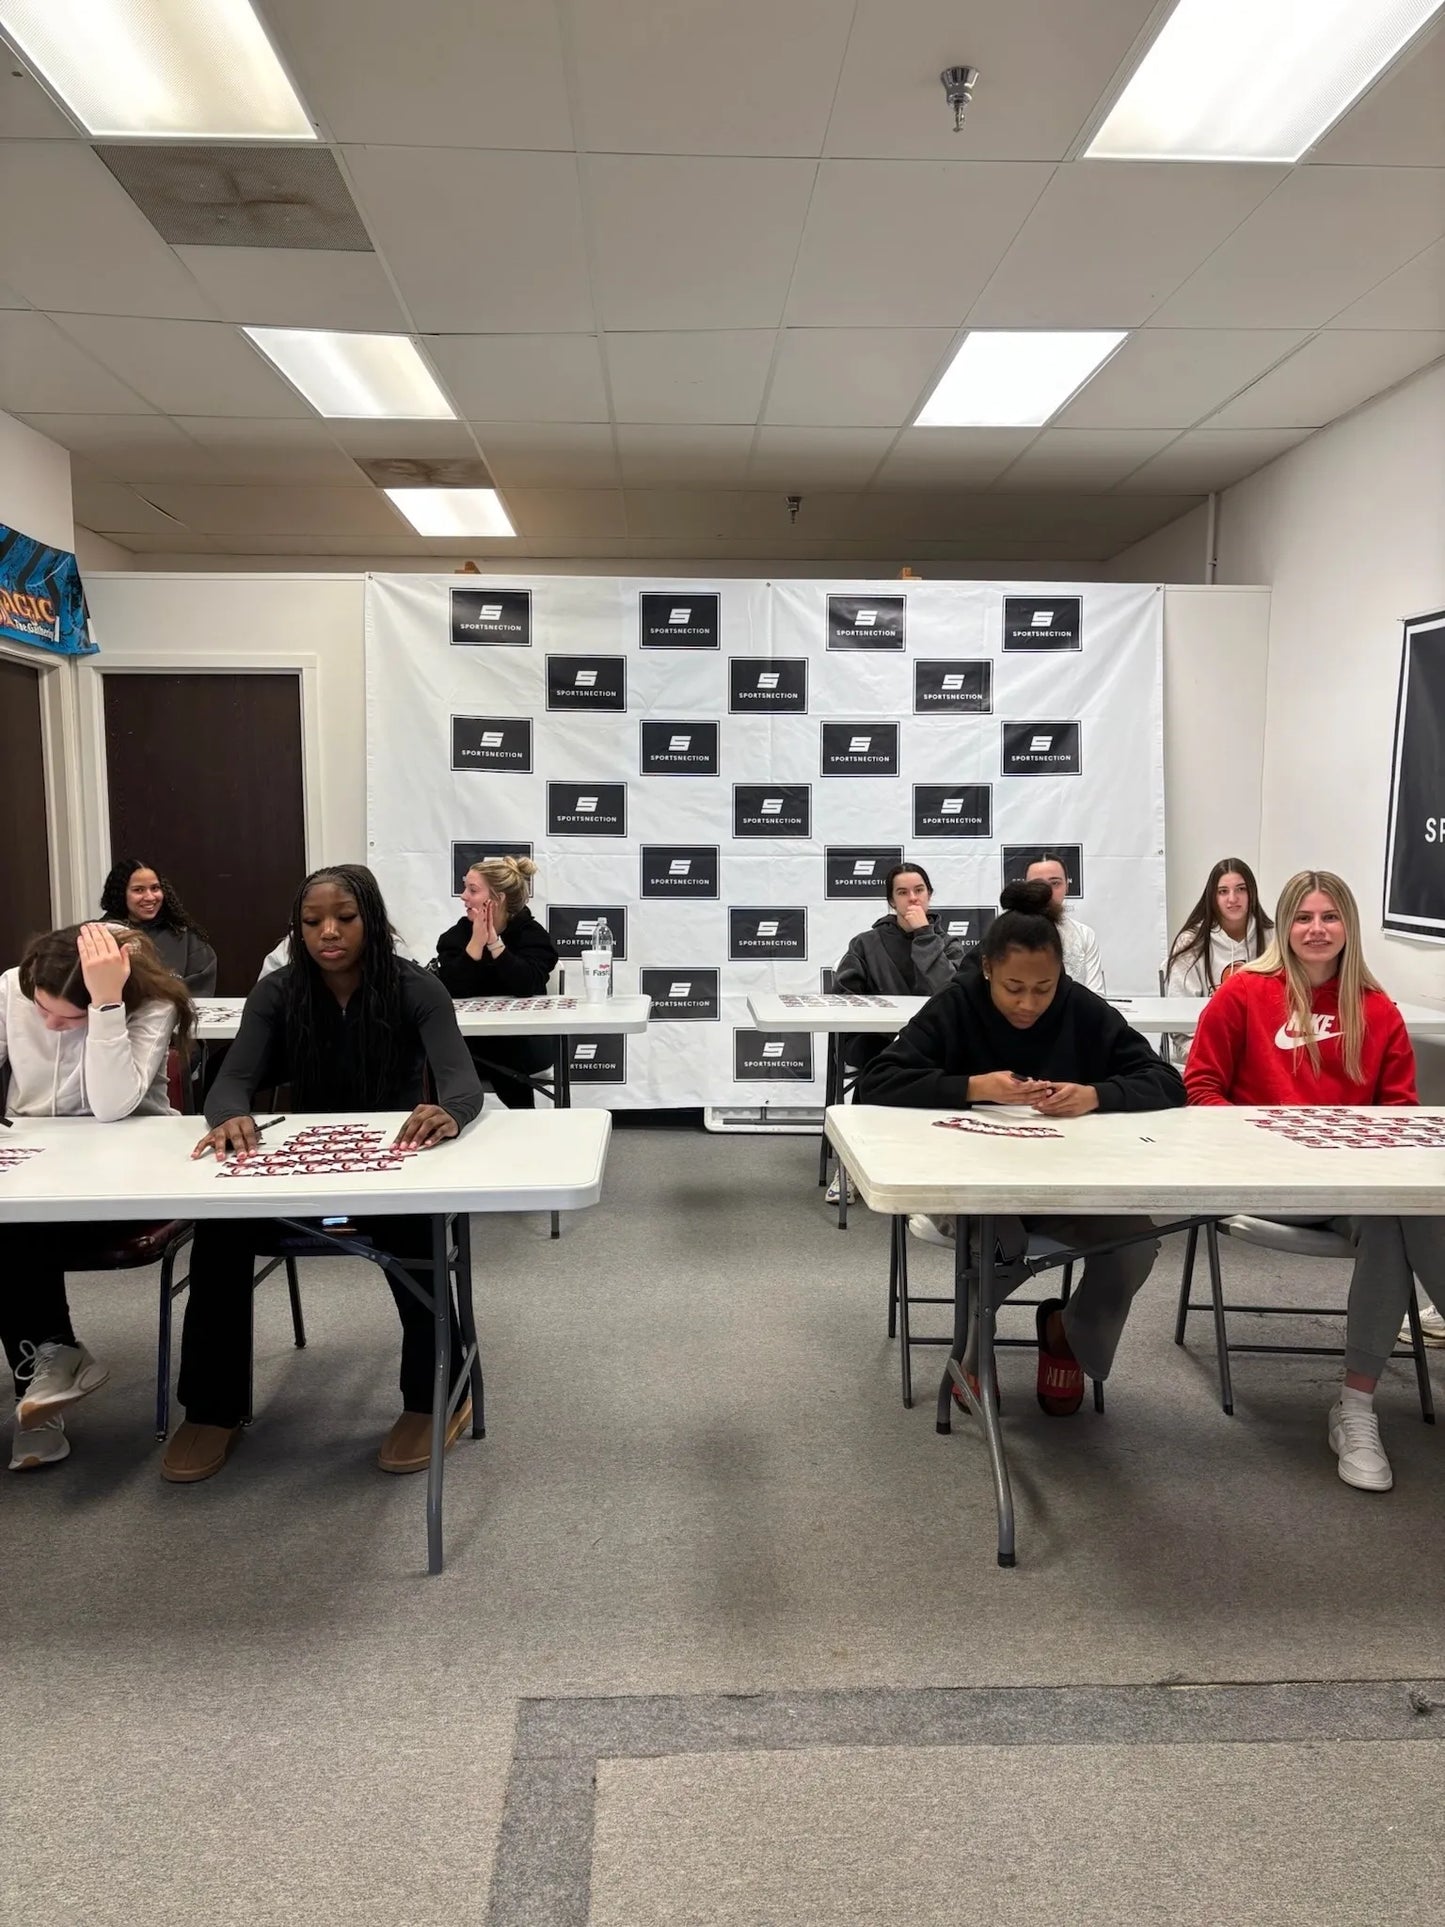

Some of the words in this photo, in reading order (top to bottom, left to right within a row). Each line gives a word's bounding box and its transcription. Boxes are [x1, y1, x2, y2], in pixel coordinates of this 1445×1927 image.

[0, 587, 57, 627] AGIC
[460, 623, 522, 631] SPORTSNECTION
[836, 629, 897, 637] SPORTSNECTION
[556, 689, 617, 697] SPORTSNECTION
[923, 693, 983, 701] SPORTSNECTION
[461, 749, 523, 759] SPORTSNECTION
[650, 754, 710, 762] SPORTSNECTION
[1011, 754, 1072, 762] SPORTSNECTION
[830, 755, 890, 763] SPORTSNECTION
[556, 815, 617, 823] SPORTSNECTION
[1286, 1010, 1335, 1035] NKE
